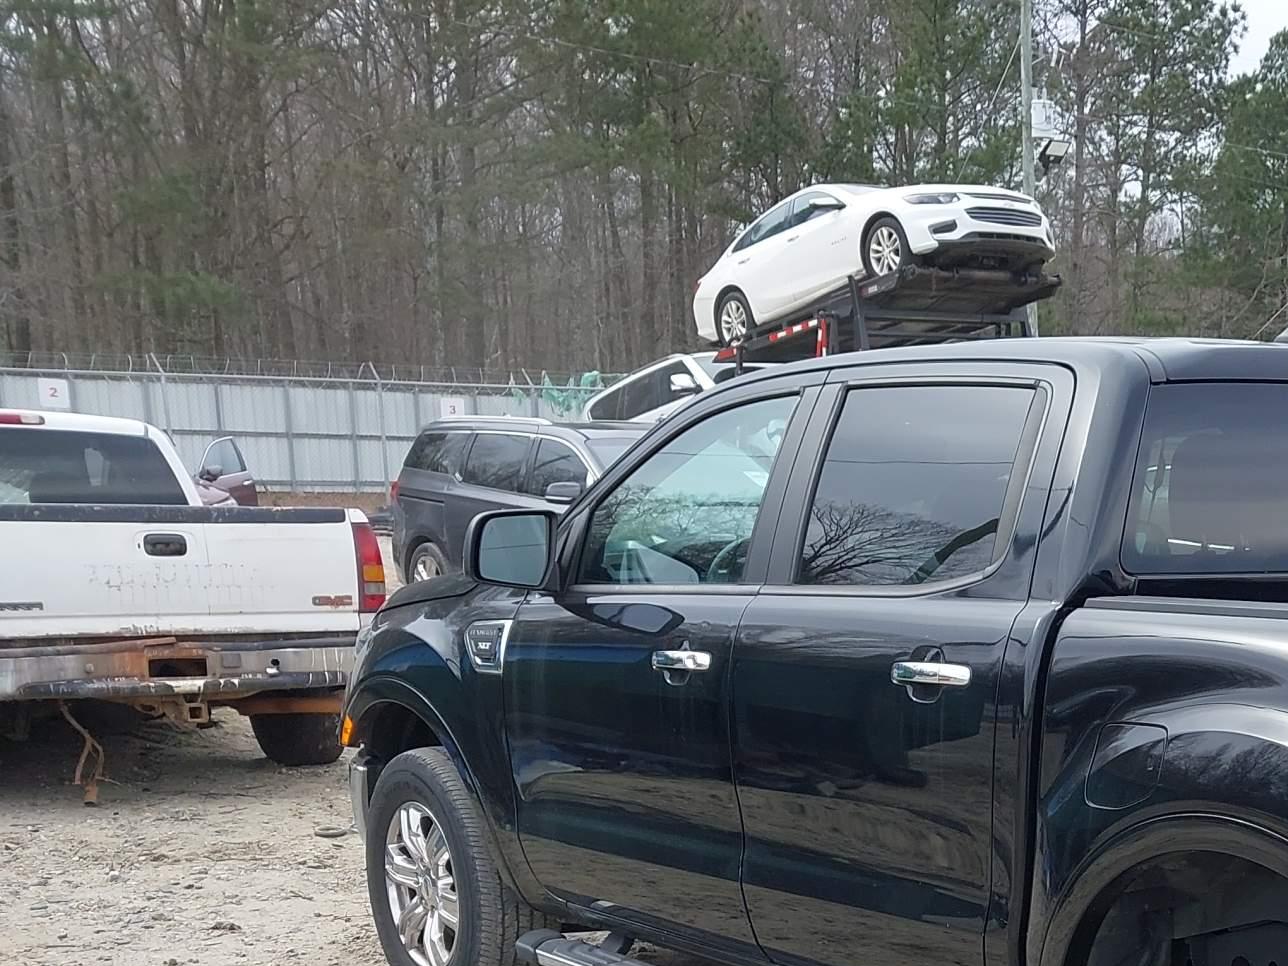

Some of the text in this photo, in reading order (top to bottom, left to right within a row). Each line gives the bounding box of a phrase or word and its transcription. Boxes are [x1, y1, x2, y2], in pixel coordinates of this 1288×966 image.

[48, 387, 59, 398] 2
[449, 405, 456, 415] 3
[477, 641, 492, 649] XLT
